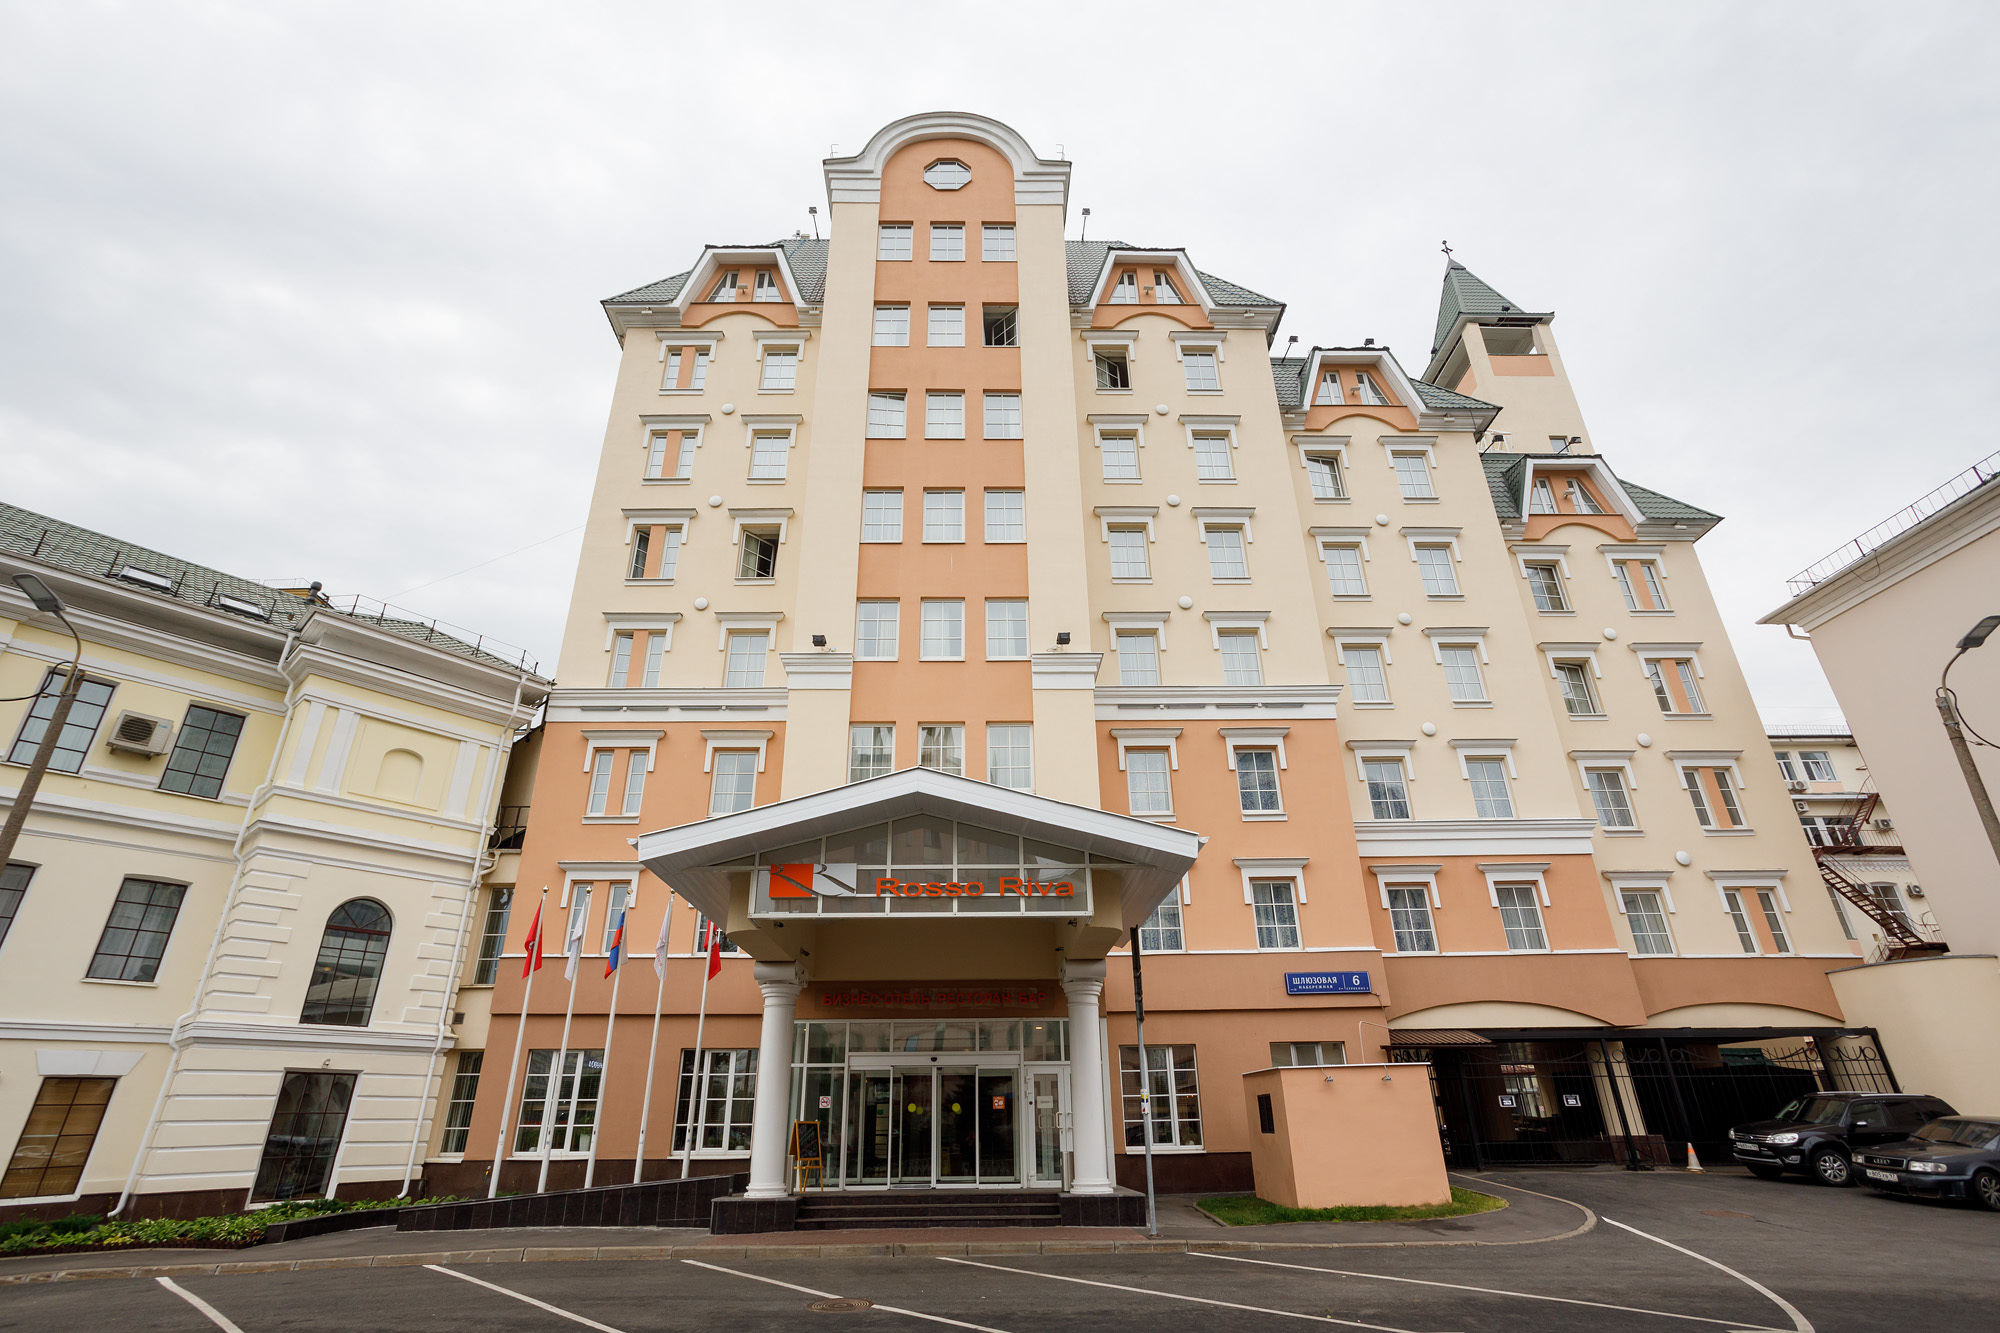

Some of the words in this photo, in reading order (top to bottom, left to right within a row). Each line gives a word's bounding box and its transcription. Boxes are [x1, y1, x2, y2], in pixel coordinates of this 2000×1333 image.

[876, 877, 985, 897] Rosso
[999, 876, 1075, 897] Riva
[1292, 976, 1338, 984] ШЛЮЗОВАЯ
[1352, 975, 1360, 986] 6
[937, 992, 1011, 1005] РЕСТОРАН
[1018, 992, 1047, 1005] БАР
